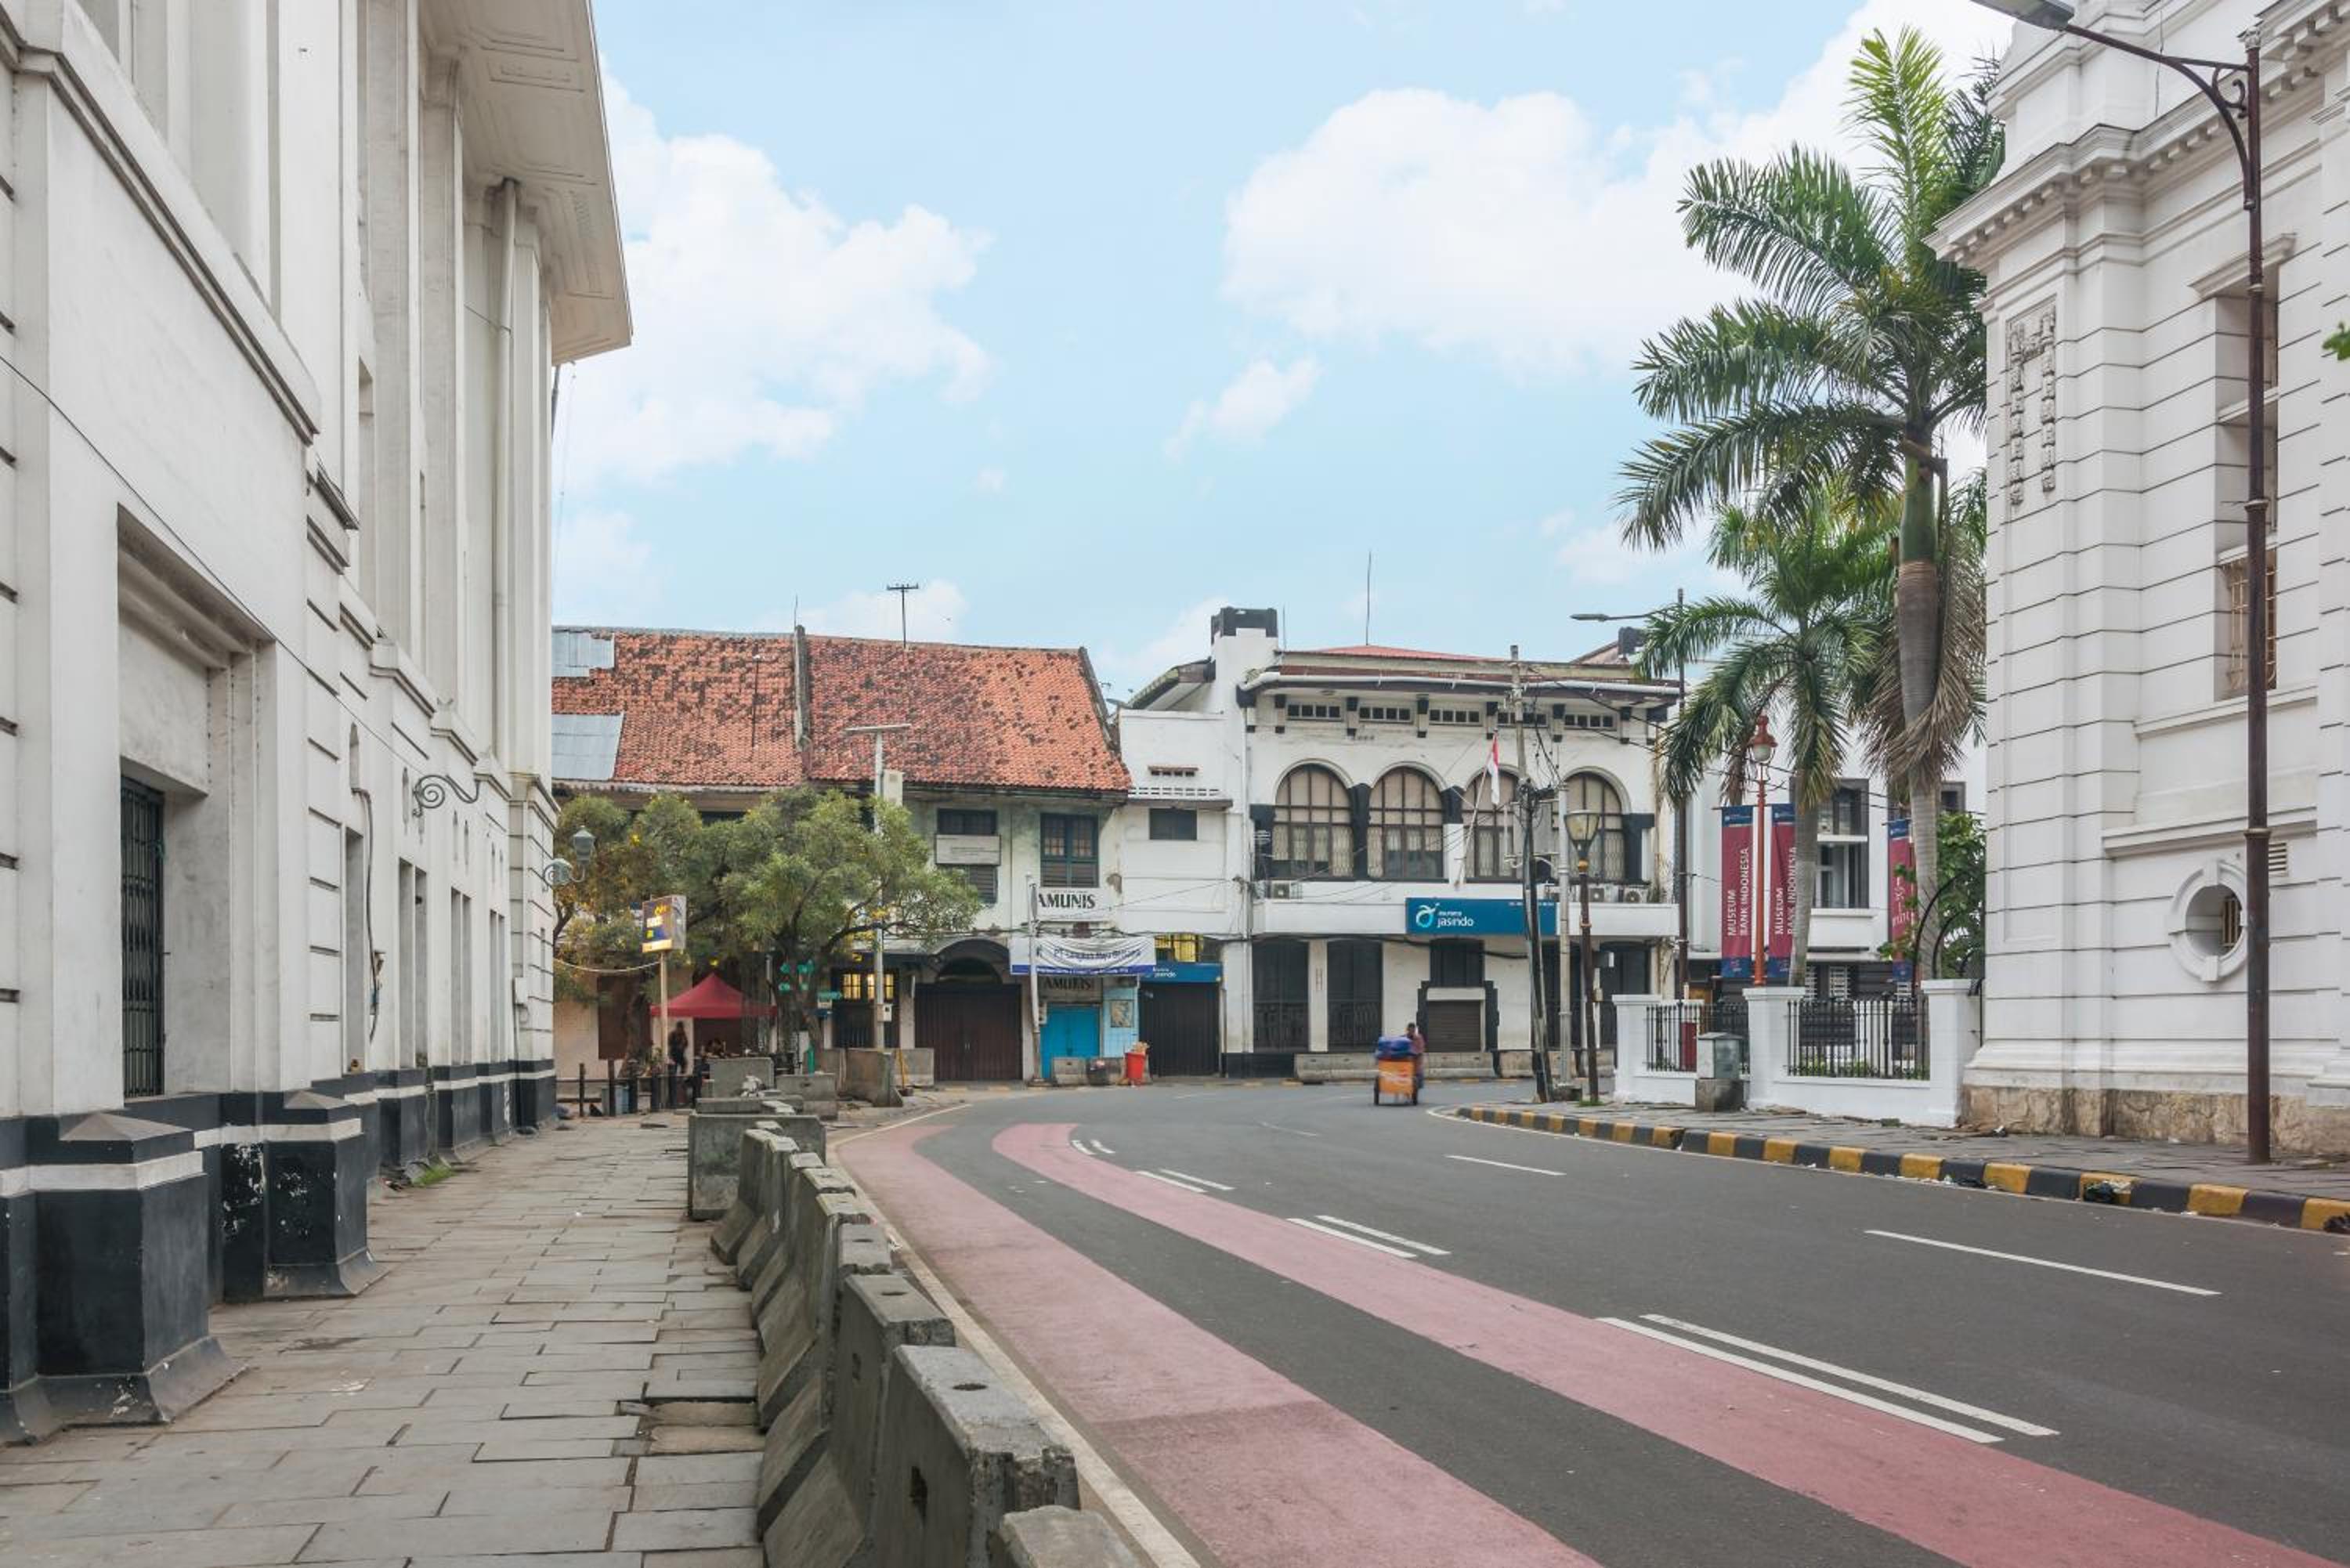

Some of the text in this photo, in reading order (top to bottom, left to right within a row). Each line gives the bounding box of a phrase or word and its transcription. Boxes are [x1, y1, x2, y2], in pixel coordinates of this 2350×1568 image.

[1727, 889, 1737, 936] MUSEUM
[1739, 847, 1749, 936] BANK INDONESIA
[1774, 887, 1784, 935] MUSEUM
[1437, 916, 1473, 927] jasindo
